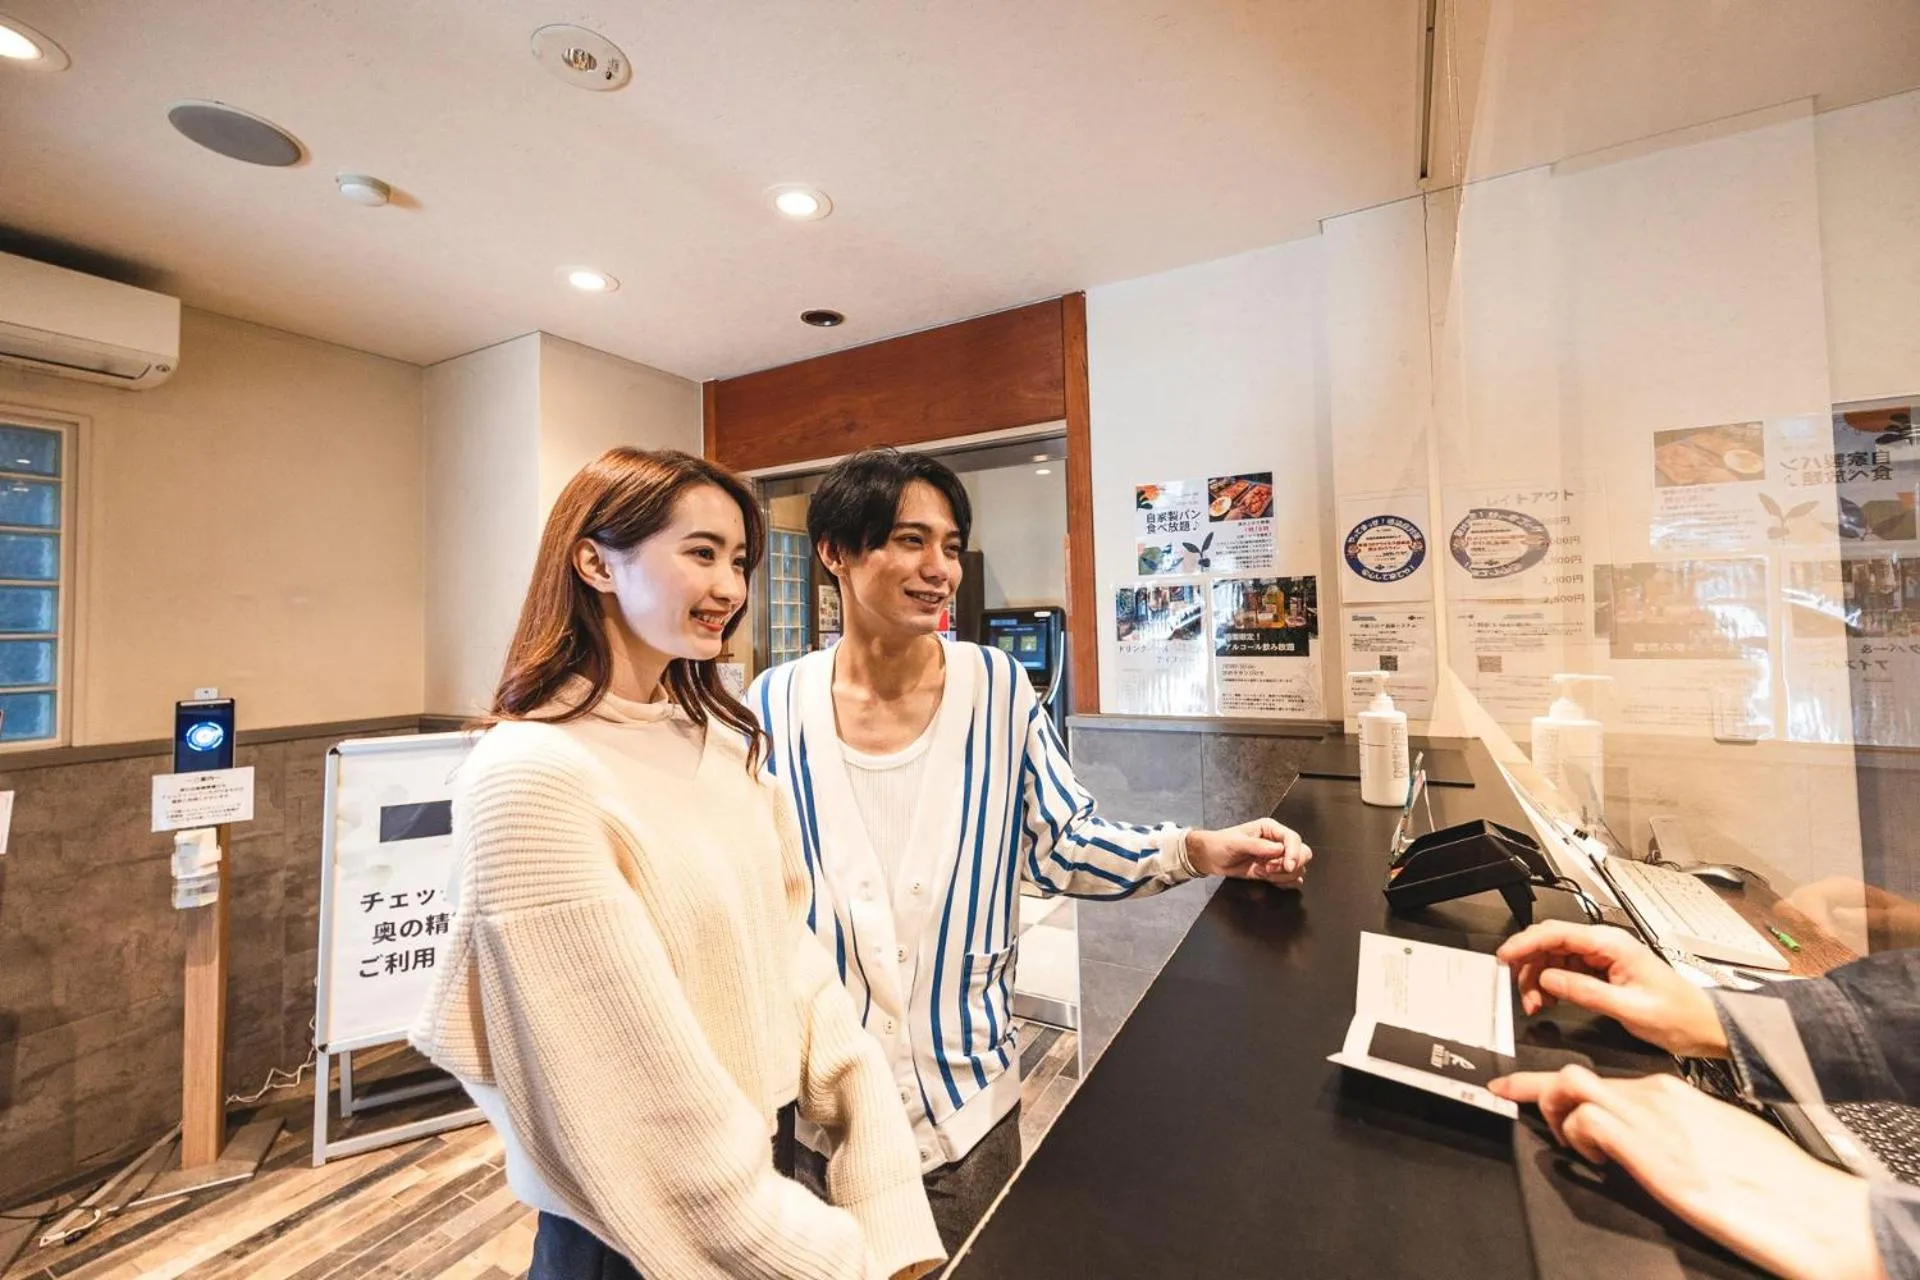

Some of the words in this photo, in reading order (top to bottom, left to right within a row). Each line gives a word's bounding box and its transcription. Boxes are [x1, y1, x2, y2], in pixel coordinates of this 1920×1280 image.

[1146, 510, 1201, 523] 自家製パン
[360, 889, 446, 913] チェッ
[372, 912, 457, 945] 奥の精
[359, 946, 436, 978] ご利用
